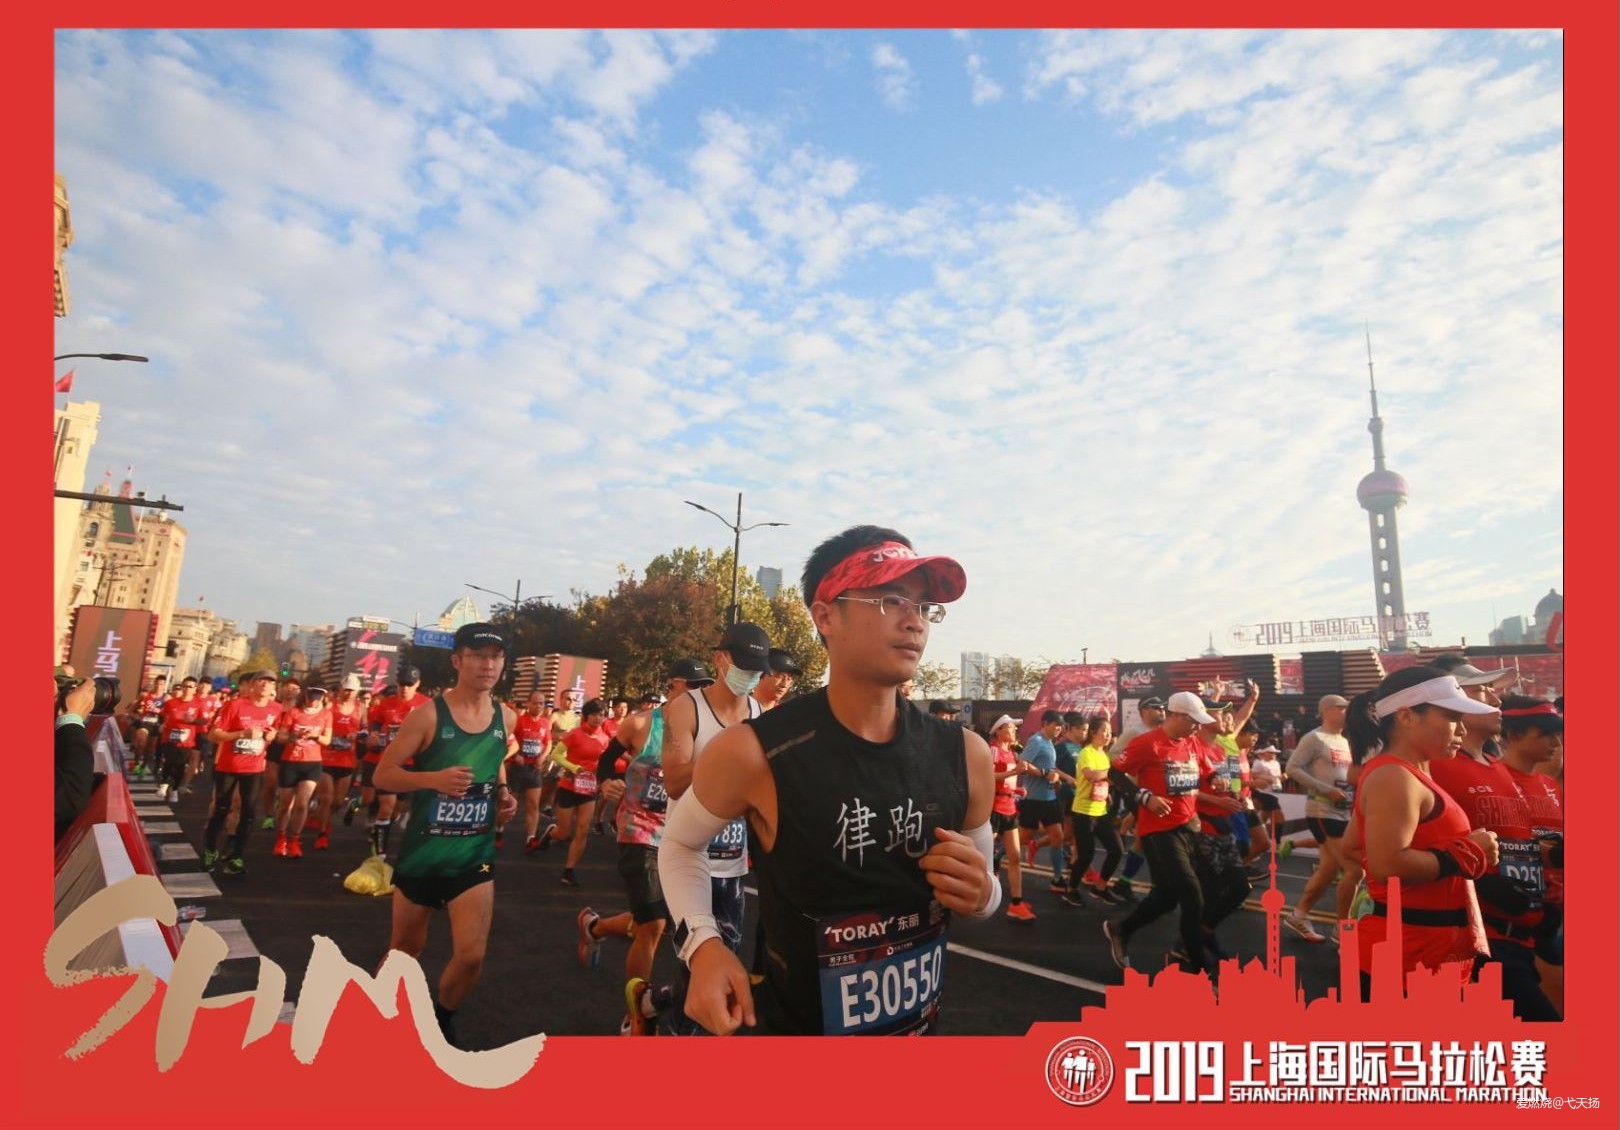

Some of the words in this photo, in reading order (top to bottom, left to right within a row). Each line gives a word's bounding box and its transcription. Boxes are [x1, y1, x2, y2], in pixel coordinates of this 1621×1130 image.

[1256, 623, 1293, 646] 2019
[436, 802, 488, 822] E29219
[833, 798, 928, 867] 律跑
[898, 913, 920, 931] 东丽
[840, 945, 942, 1028] E30550
